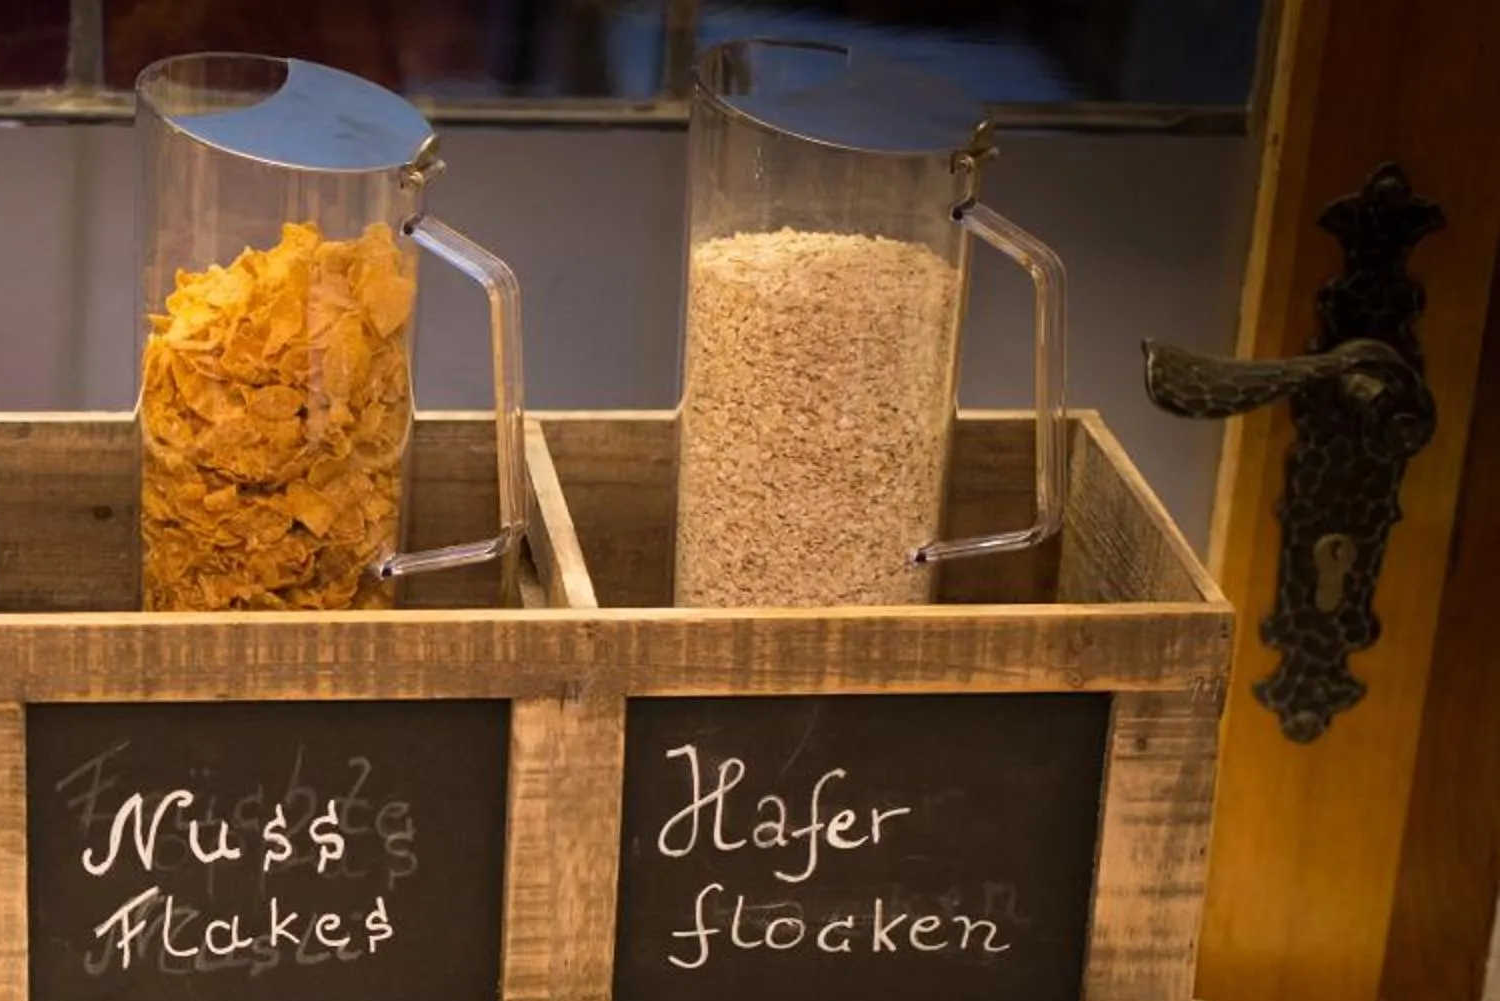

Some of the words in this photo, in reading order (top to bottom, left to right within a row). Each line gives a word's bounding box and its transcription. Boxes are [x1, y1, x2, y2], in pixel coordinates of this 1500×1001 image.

[82, 789, 346, 875] Nuss
[658, 745, 911, 883] Hafer
[94, 886, 395, 971] Flakes
